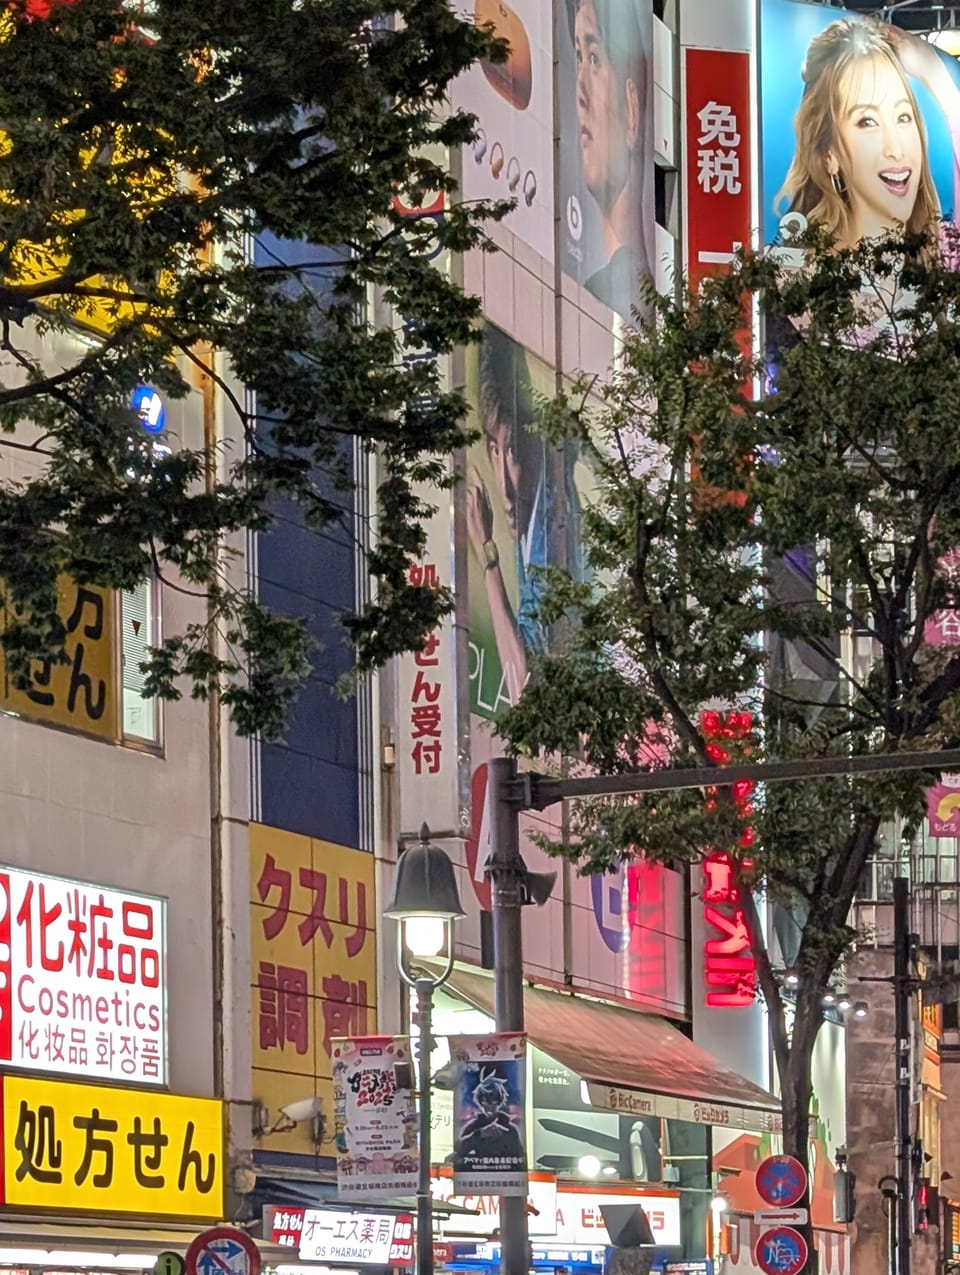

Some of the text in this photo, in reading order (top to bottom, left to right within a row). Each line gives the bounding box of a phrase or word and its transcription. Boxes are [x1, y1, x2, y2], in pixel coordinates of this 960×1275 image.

[697, 101, 741, 195] 免税
[410, 564, 442, 774] 処せん受付
[16, 880, 160, 989] 化粧品
[257, 853, 367, 958] クスリ
[17, 974, 161, 1032] Cosmetics
[19, 1020, 161, 1078] 化妆品 화장품
[357, 1090, 394, 1107] 2025
[15, 1100, 216, 1194] 処方せん
[274, 1212, 302, 1230] 処方せん
[305, 1216, 390, 1245] オーエス薬局
[315, 1246, 373, 1258] OS PHARMACY
